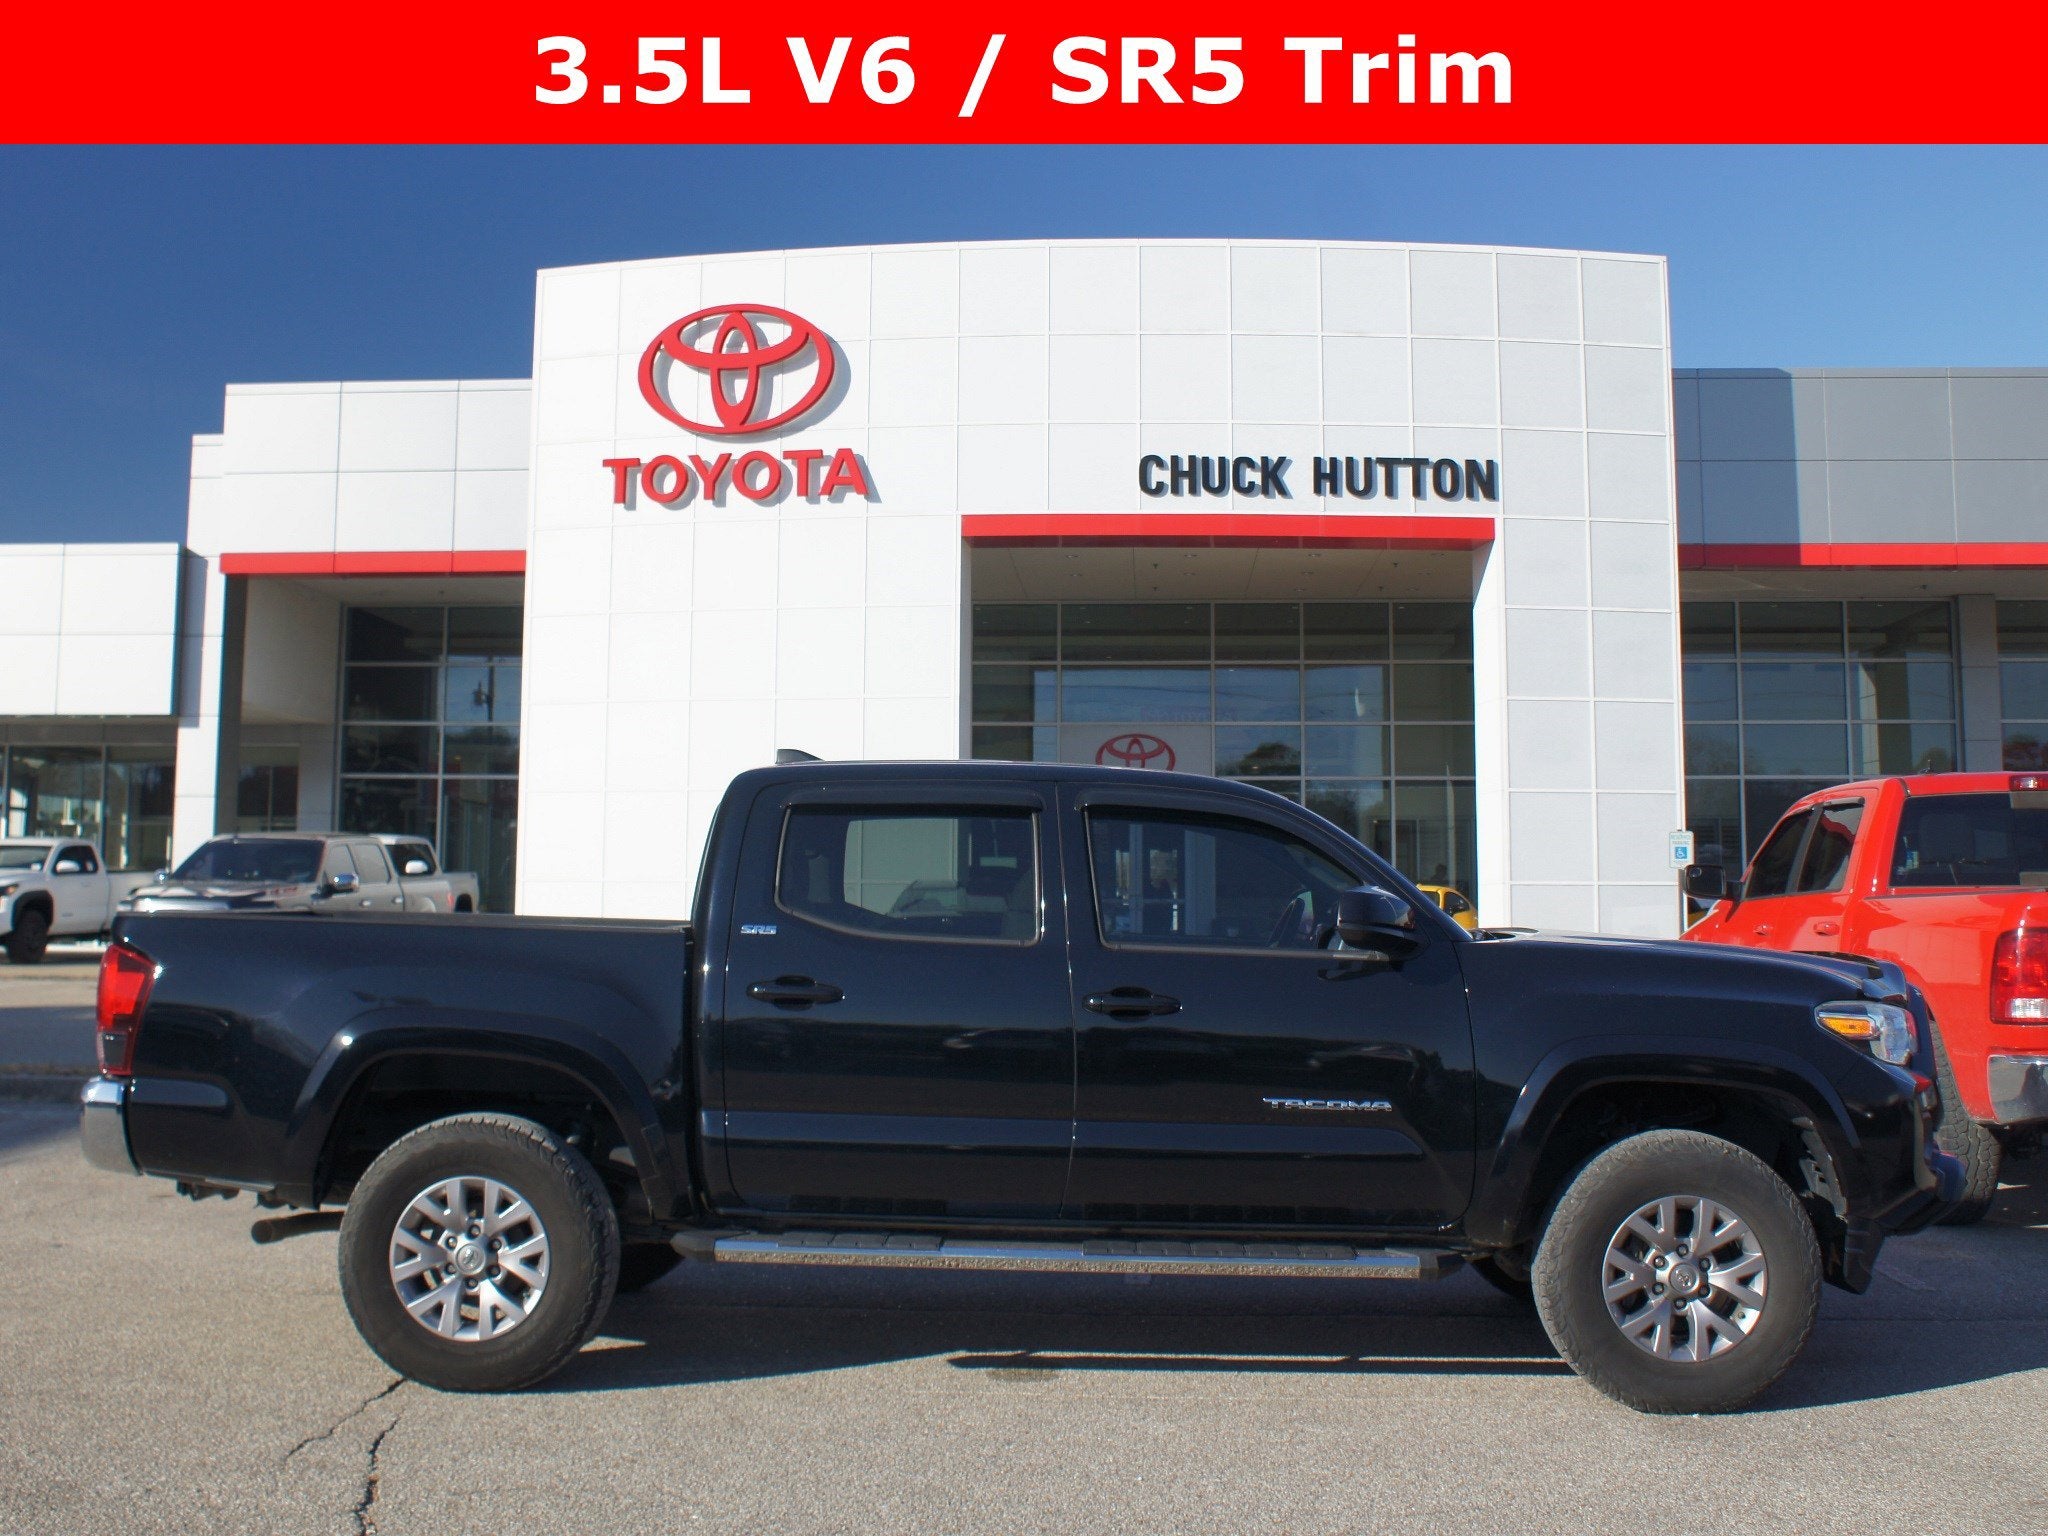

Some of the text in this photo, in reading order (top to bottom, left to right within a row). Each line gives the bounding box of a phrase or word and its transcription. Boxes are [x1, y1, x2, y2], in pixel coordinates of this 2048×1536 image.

[602, 448, 869, 505] TOYOTA
[1138, 454, 1497, 501] CHUCK HUTTON
[740, 924, 778, 935] SR5
[1262, 1097, 1393, 1112] TACOMA
